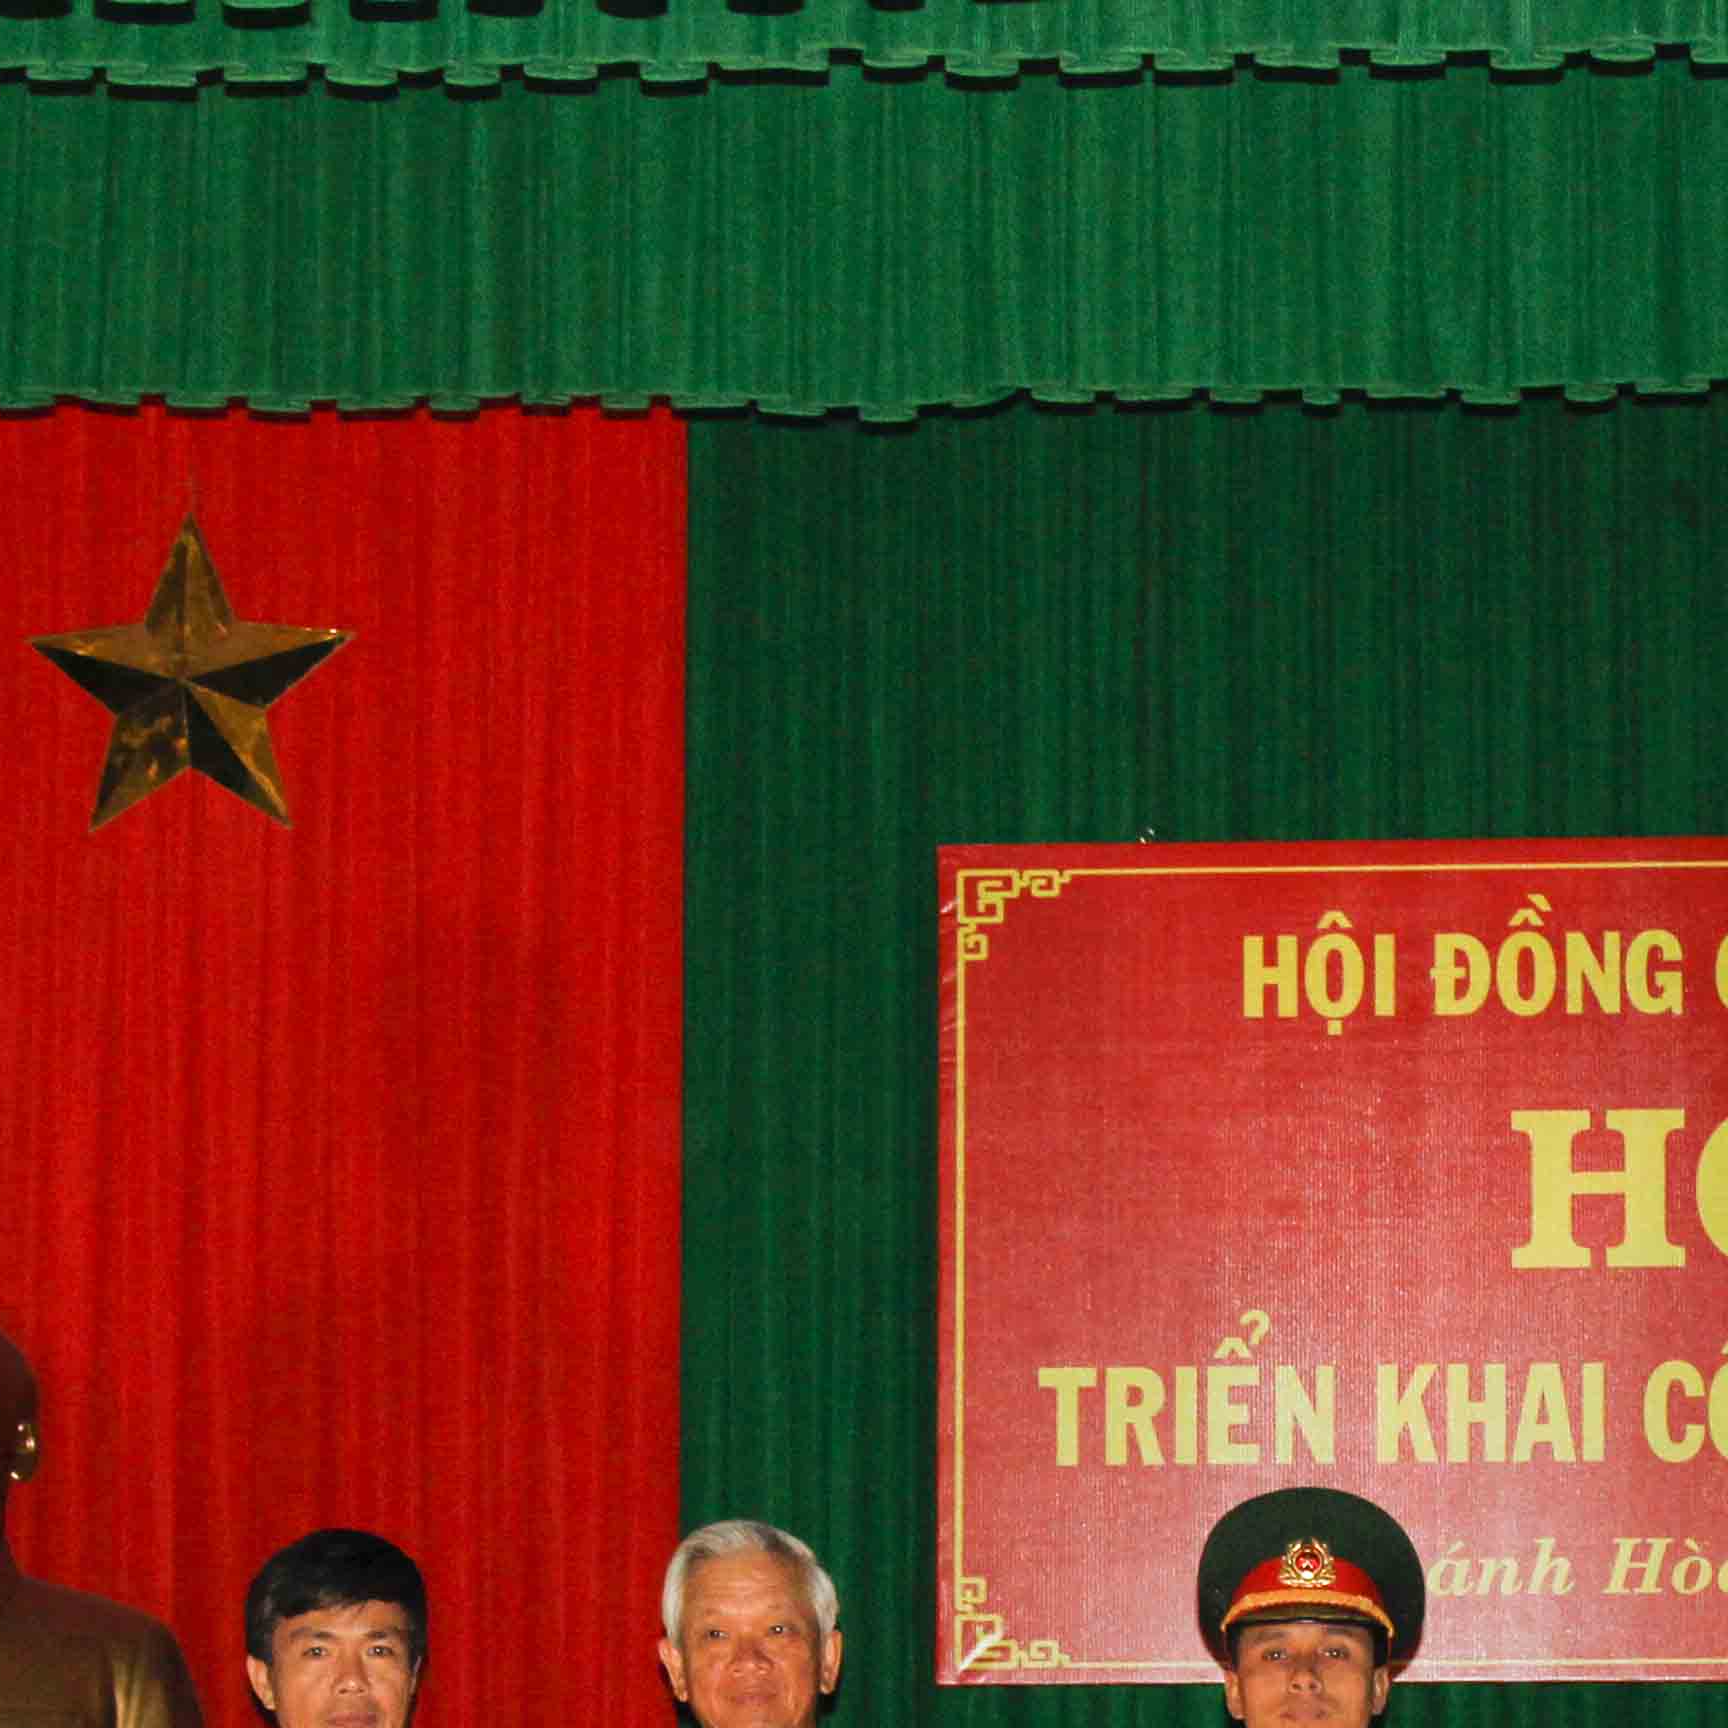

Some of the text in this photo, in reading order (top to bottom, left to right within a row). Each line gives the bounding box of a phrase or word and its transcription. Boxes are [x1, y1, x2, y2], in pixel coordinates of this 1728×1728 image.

[1244, 911, 1396, 1035] HỘI
[1429, 894, 1683, 1017] ĐỒNG
[1037, 1308, 1342, 1472] TRIỂN
[1375, 1358, 1612, 1468] KHAI
[1427, 1537, 1576, 1596] ánh
